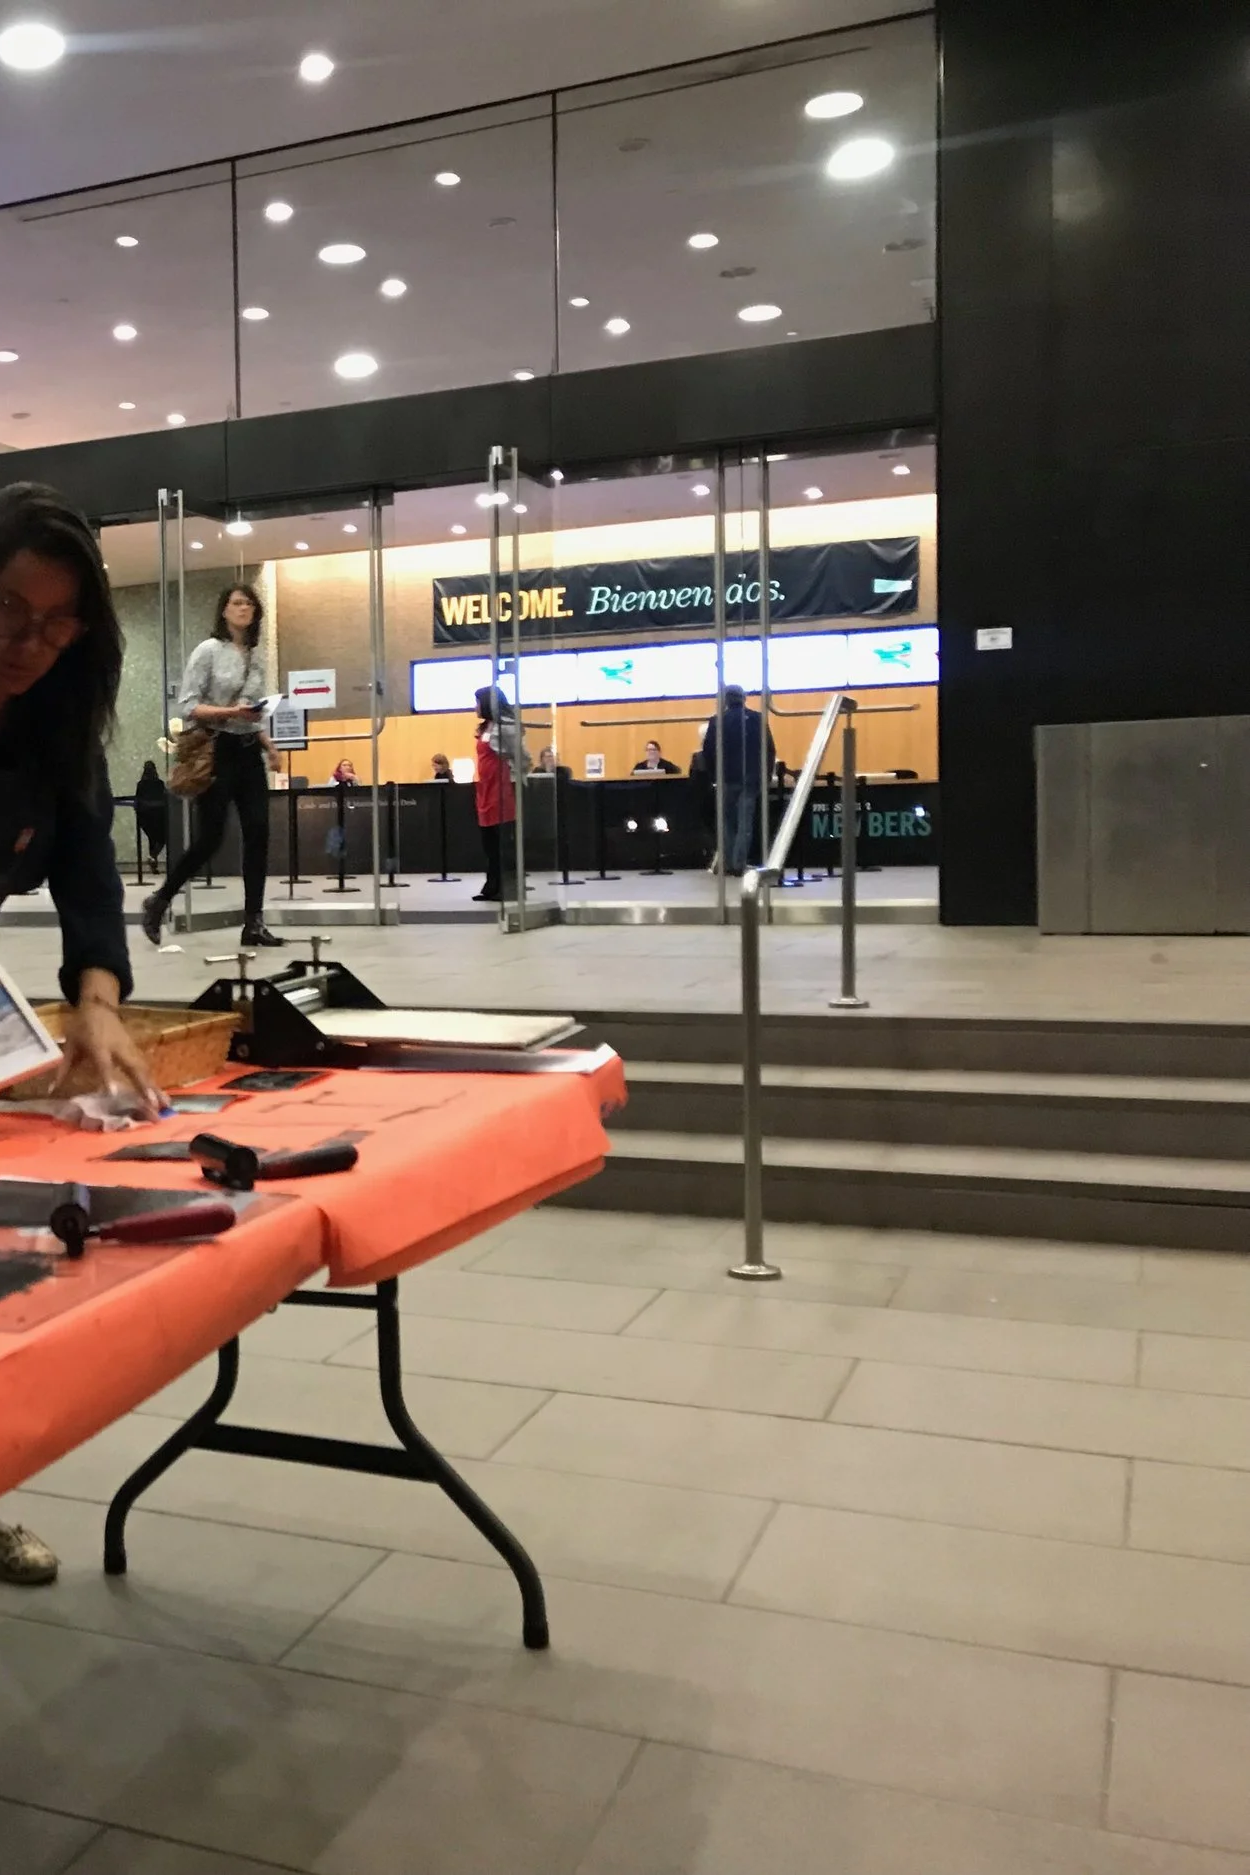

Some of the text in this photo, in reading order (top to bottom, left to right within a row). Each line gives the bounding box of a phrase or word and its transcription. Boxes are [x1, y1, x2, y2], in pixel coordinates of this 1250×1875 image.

[440, 573, 786, 627] WELCOME. Bienvendos.
[812, 810, 932, 839] MEBERS
